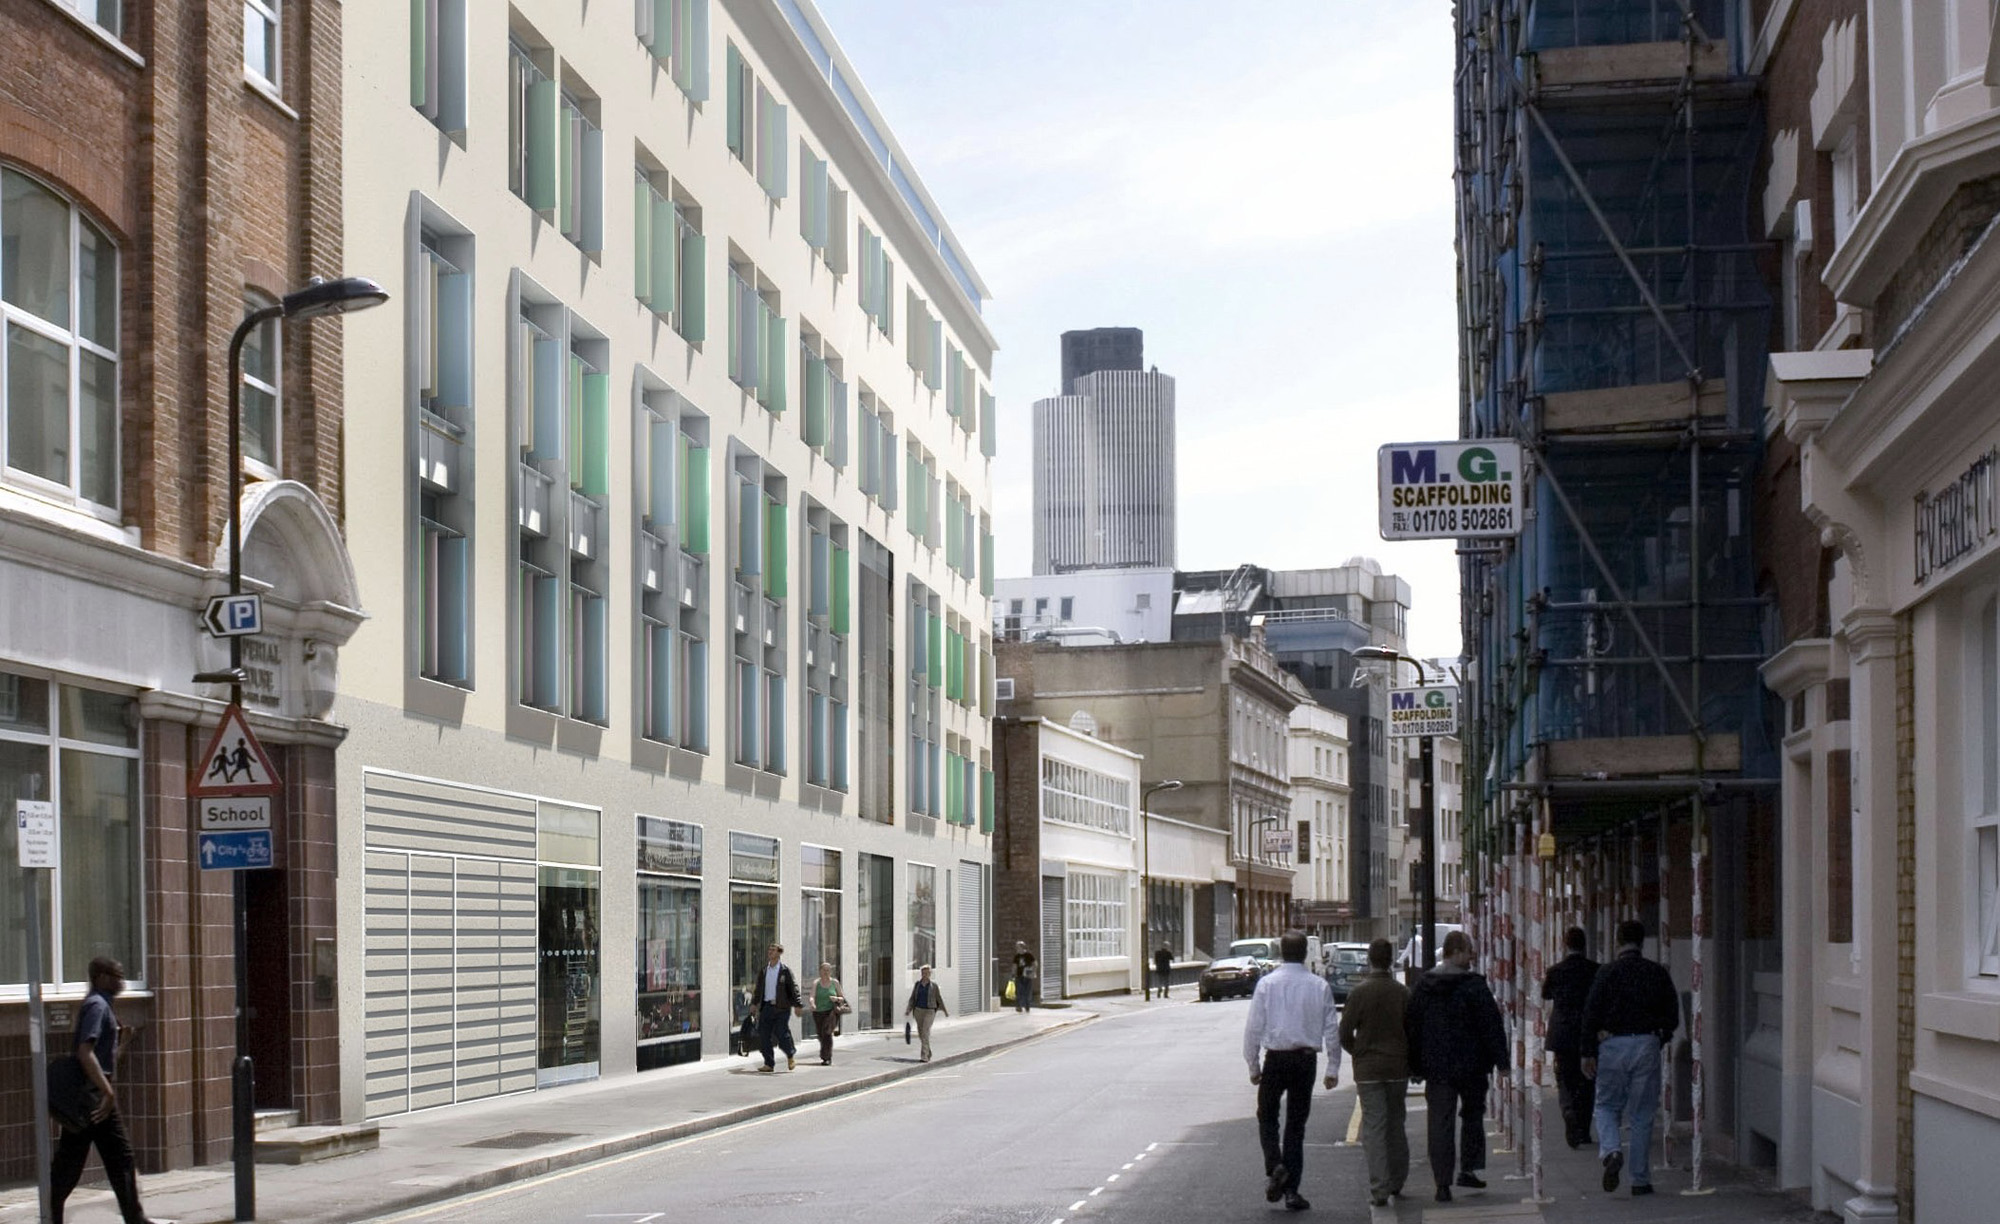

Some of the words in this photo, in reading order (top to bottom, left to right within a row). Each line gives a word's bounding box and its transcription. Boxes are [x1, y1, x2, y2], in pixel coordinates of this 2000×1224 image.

[1392, 483, 1512, 507] SCAFFOLDING
[1413, 509, 1457, 532] 01708
[1461, 507, 1513, 531] 502861
[234, 602, 253, 628] P
[1392, 708, 1452, 722] SCAFFOLDING
[207, 806, 264, 822] School
[218, 845, 237, 857] City
